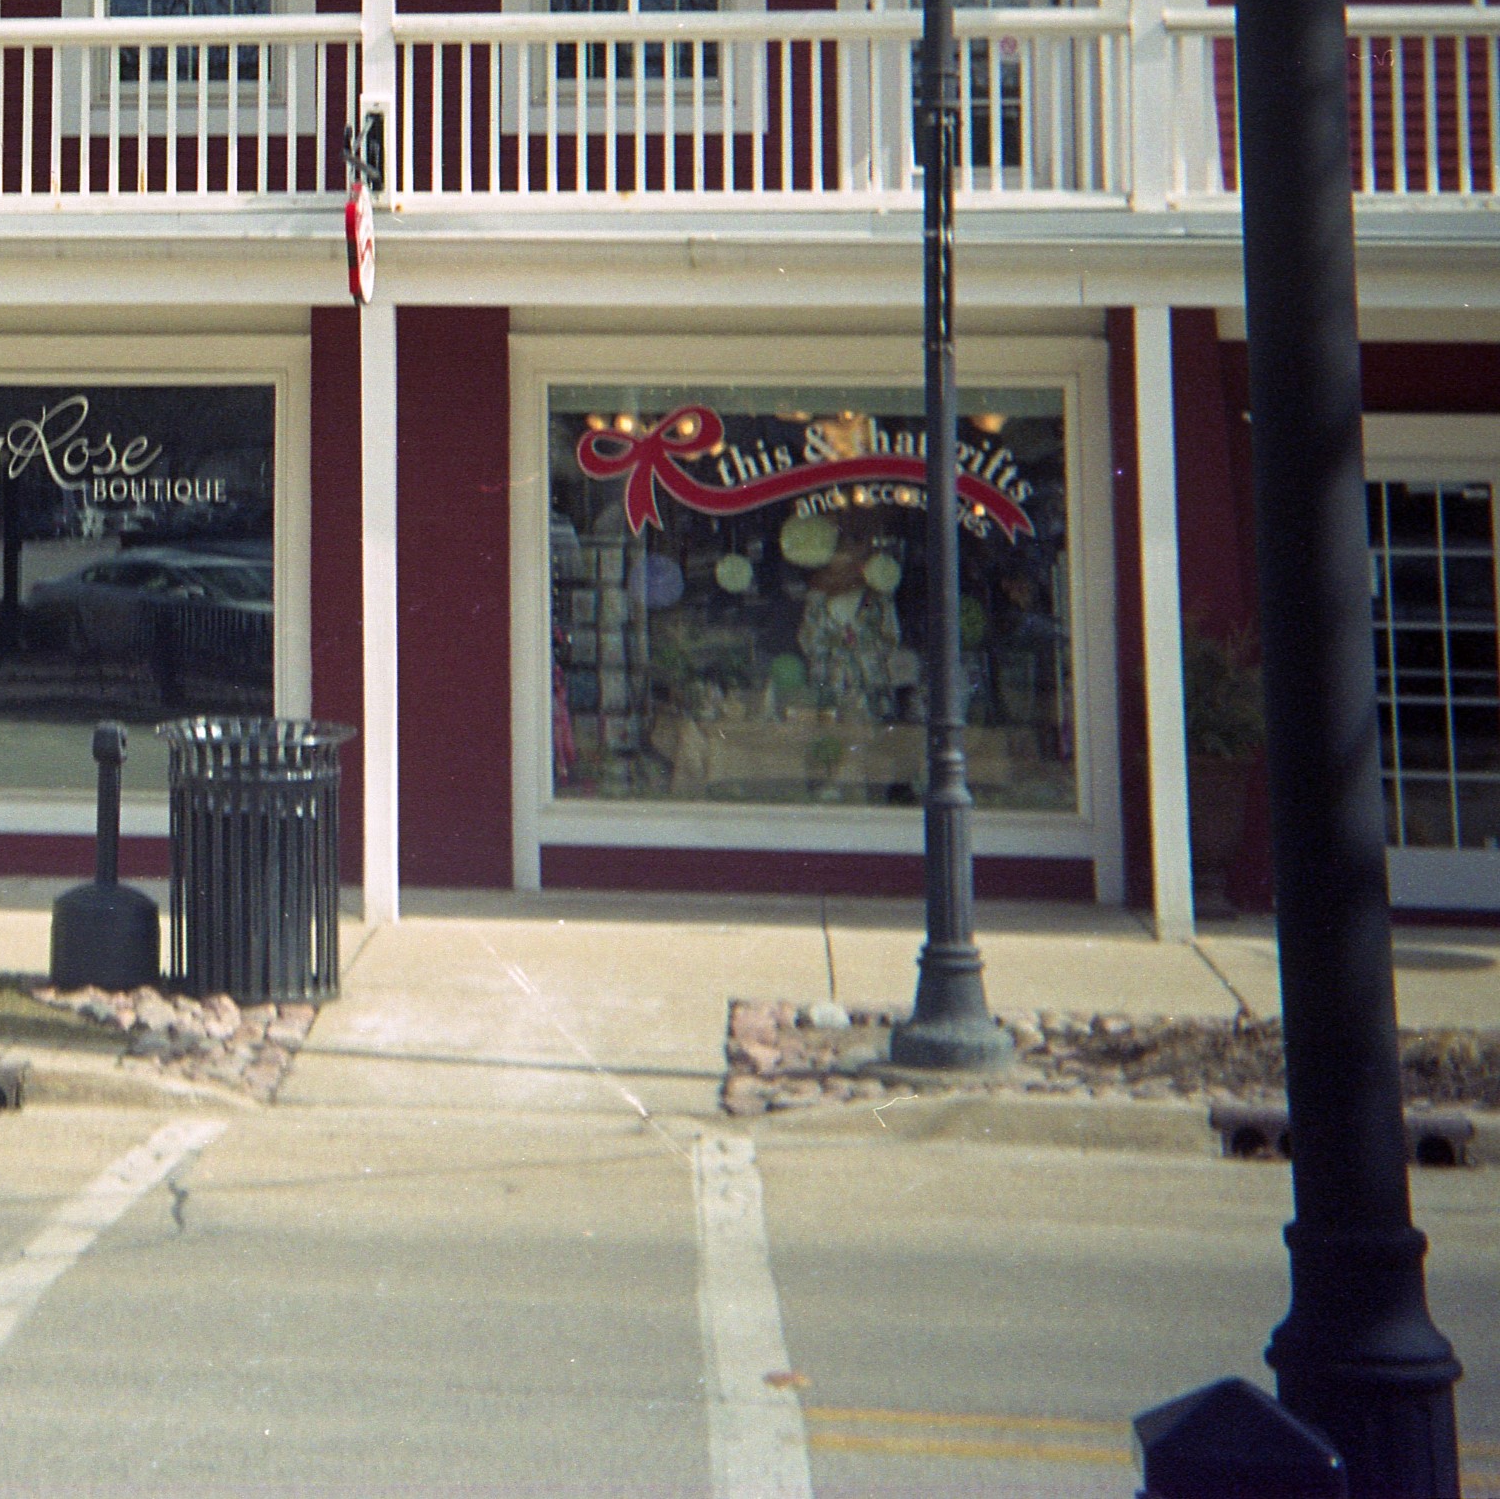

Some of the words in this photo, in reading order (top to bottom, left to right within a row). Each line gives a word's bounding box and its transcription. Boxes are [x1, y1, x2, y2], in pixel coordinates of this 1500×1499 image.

[7, 395, 163, 491] Rose
[717, 438, 793, 487] this
[804, 423, 839, 463] &
[92, 476, 228, 504] BOUTIQUE
[796, 482, 847, 519] and
